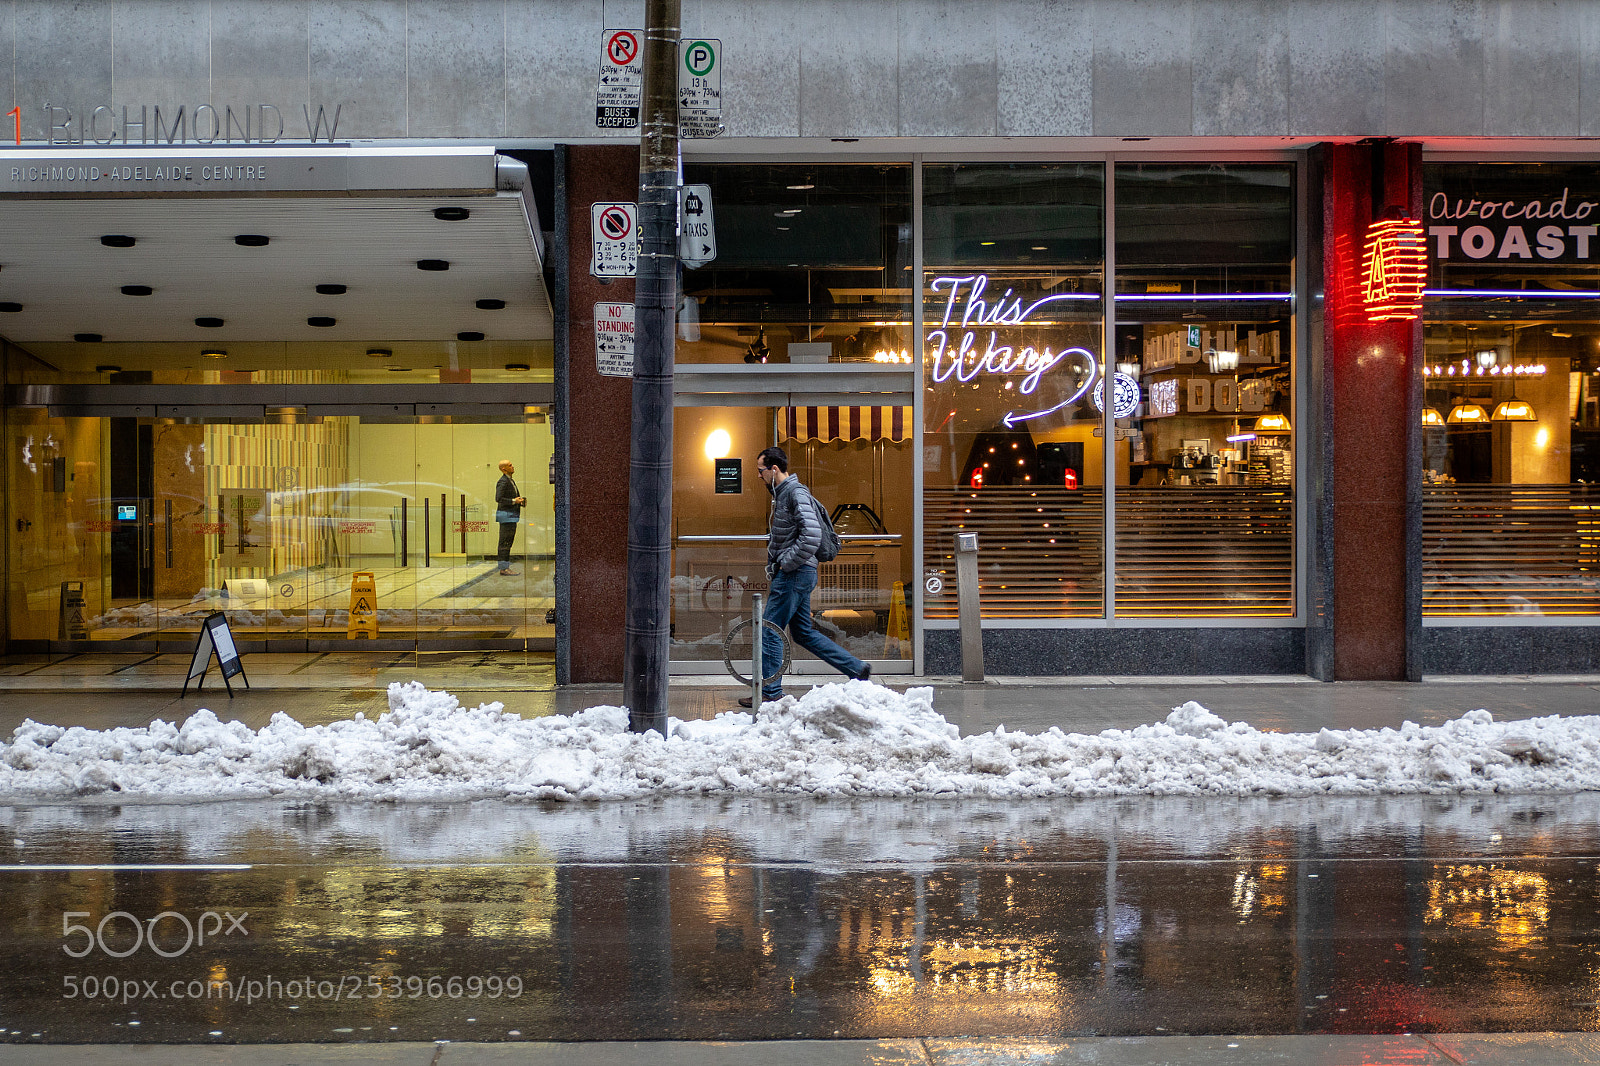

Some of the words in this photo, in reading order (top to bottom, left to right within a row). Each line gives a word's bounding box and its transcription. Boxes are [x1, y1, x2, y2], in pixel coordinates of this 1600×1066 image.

[692, 78, 700, 88] 13
[605, 108, 630, 116] BUSES
[6, 106, 21, 146] 1
[48, 104, 284, 145] RICHMOND
[303, 104, 342, 144] W
[598, 117, 637, 127] EXCEPTED
[202, 165, 266, 180] CENTRE
[688, 223, 708, 237] TAXIS
[1428, 226, 1598, 259] TOAST
[931, 274, 1022, 328] This
[609, 306, 621, 317] NO
[597, 320, 634, 333] STANDING
[926, 330, 1053, 394] Way
[1187, 379, 1266, 412] DOG
